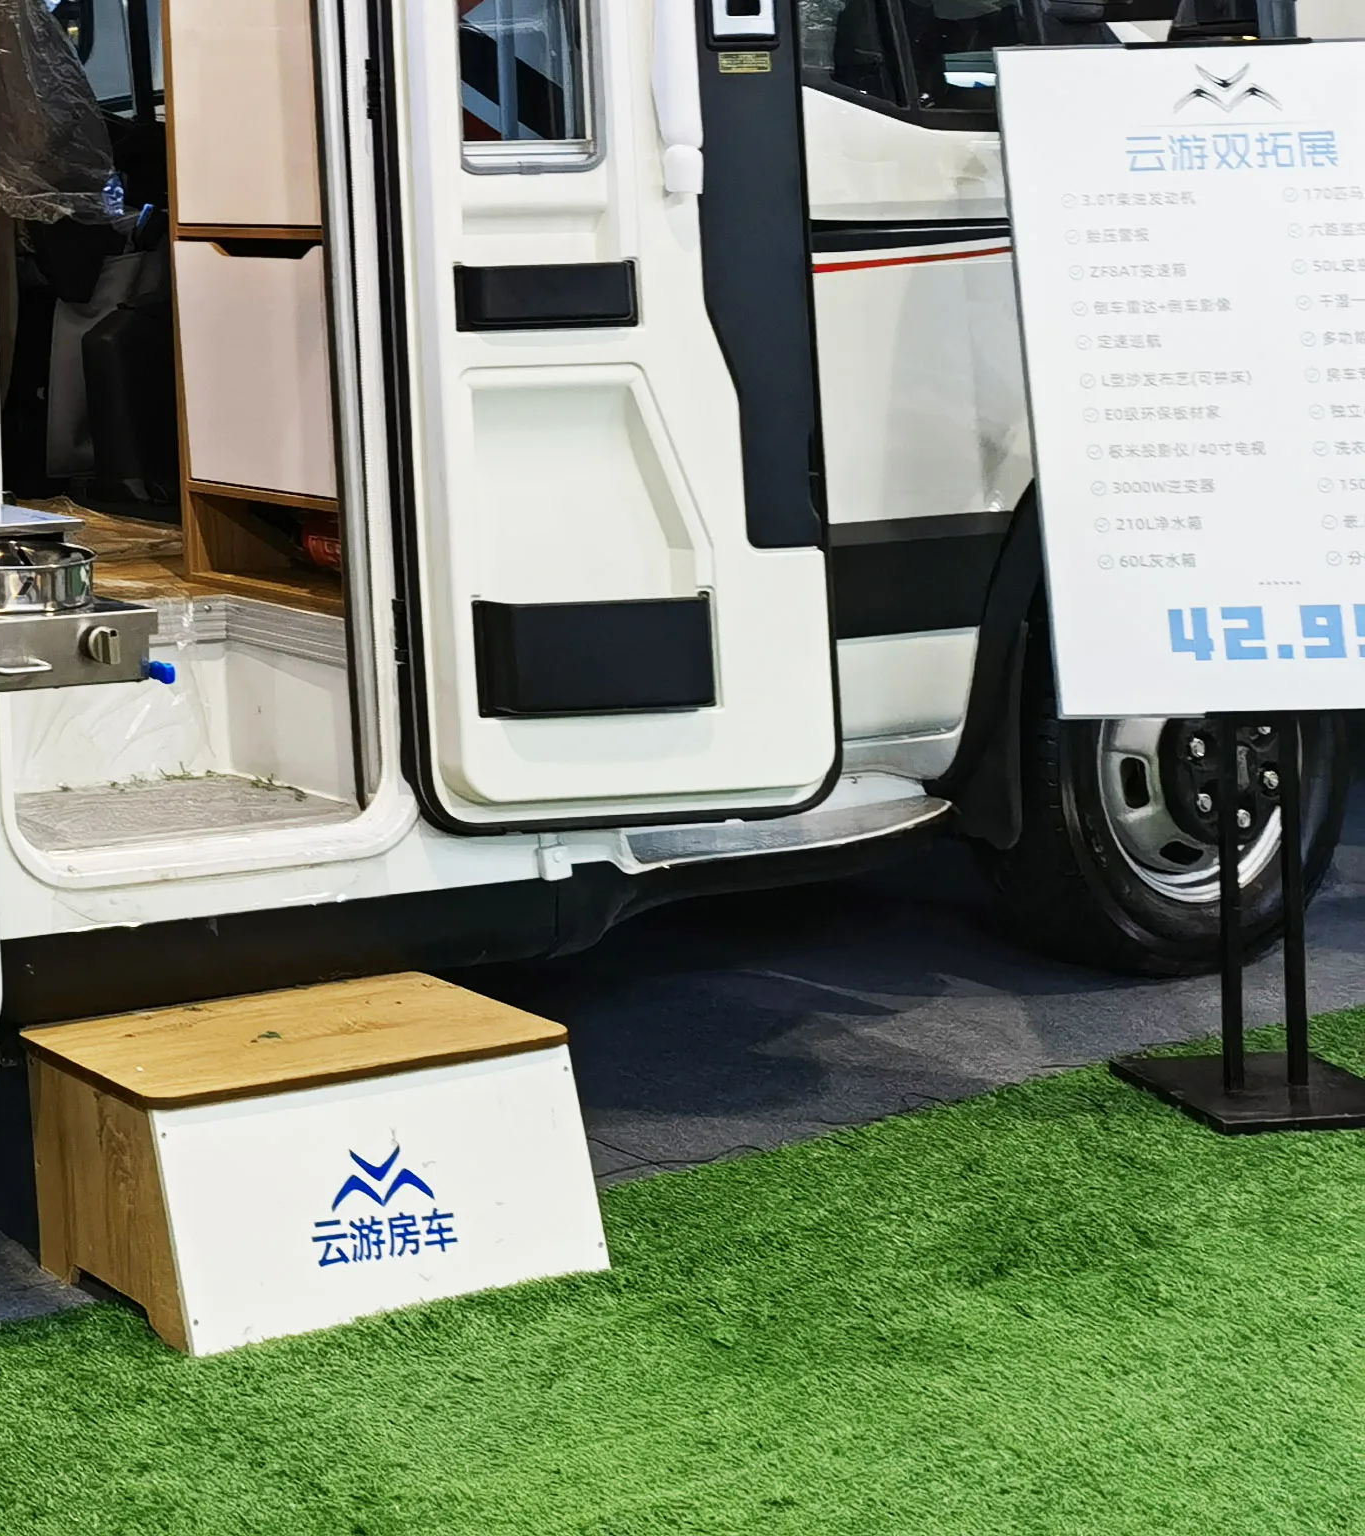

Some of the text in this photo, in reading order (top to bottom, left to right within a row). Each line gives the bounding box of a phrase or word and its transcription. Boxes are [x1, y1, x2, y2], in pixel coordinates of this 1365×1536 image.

[1124, 129, 1339, 173] 云游双拓展
[1303, 186, 1365, 201] 170匹马
[1167, 603, 1365, 661] 42.9
[311, 1208, 458, 1268] 云游房车
